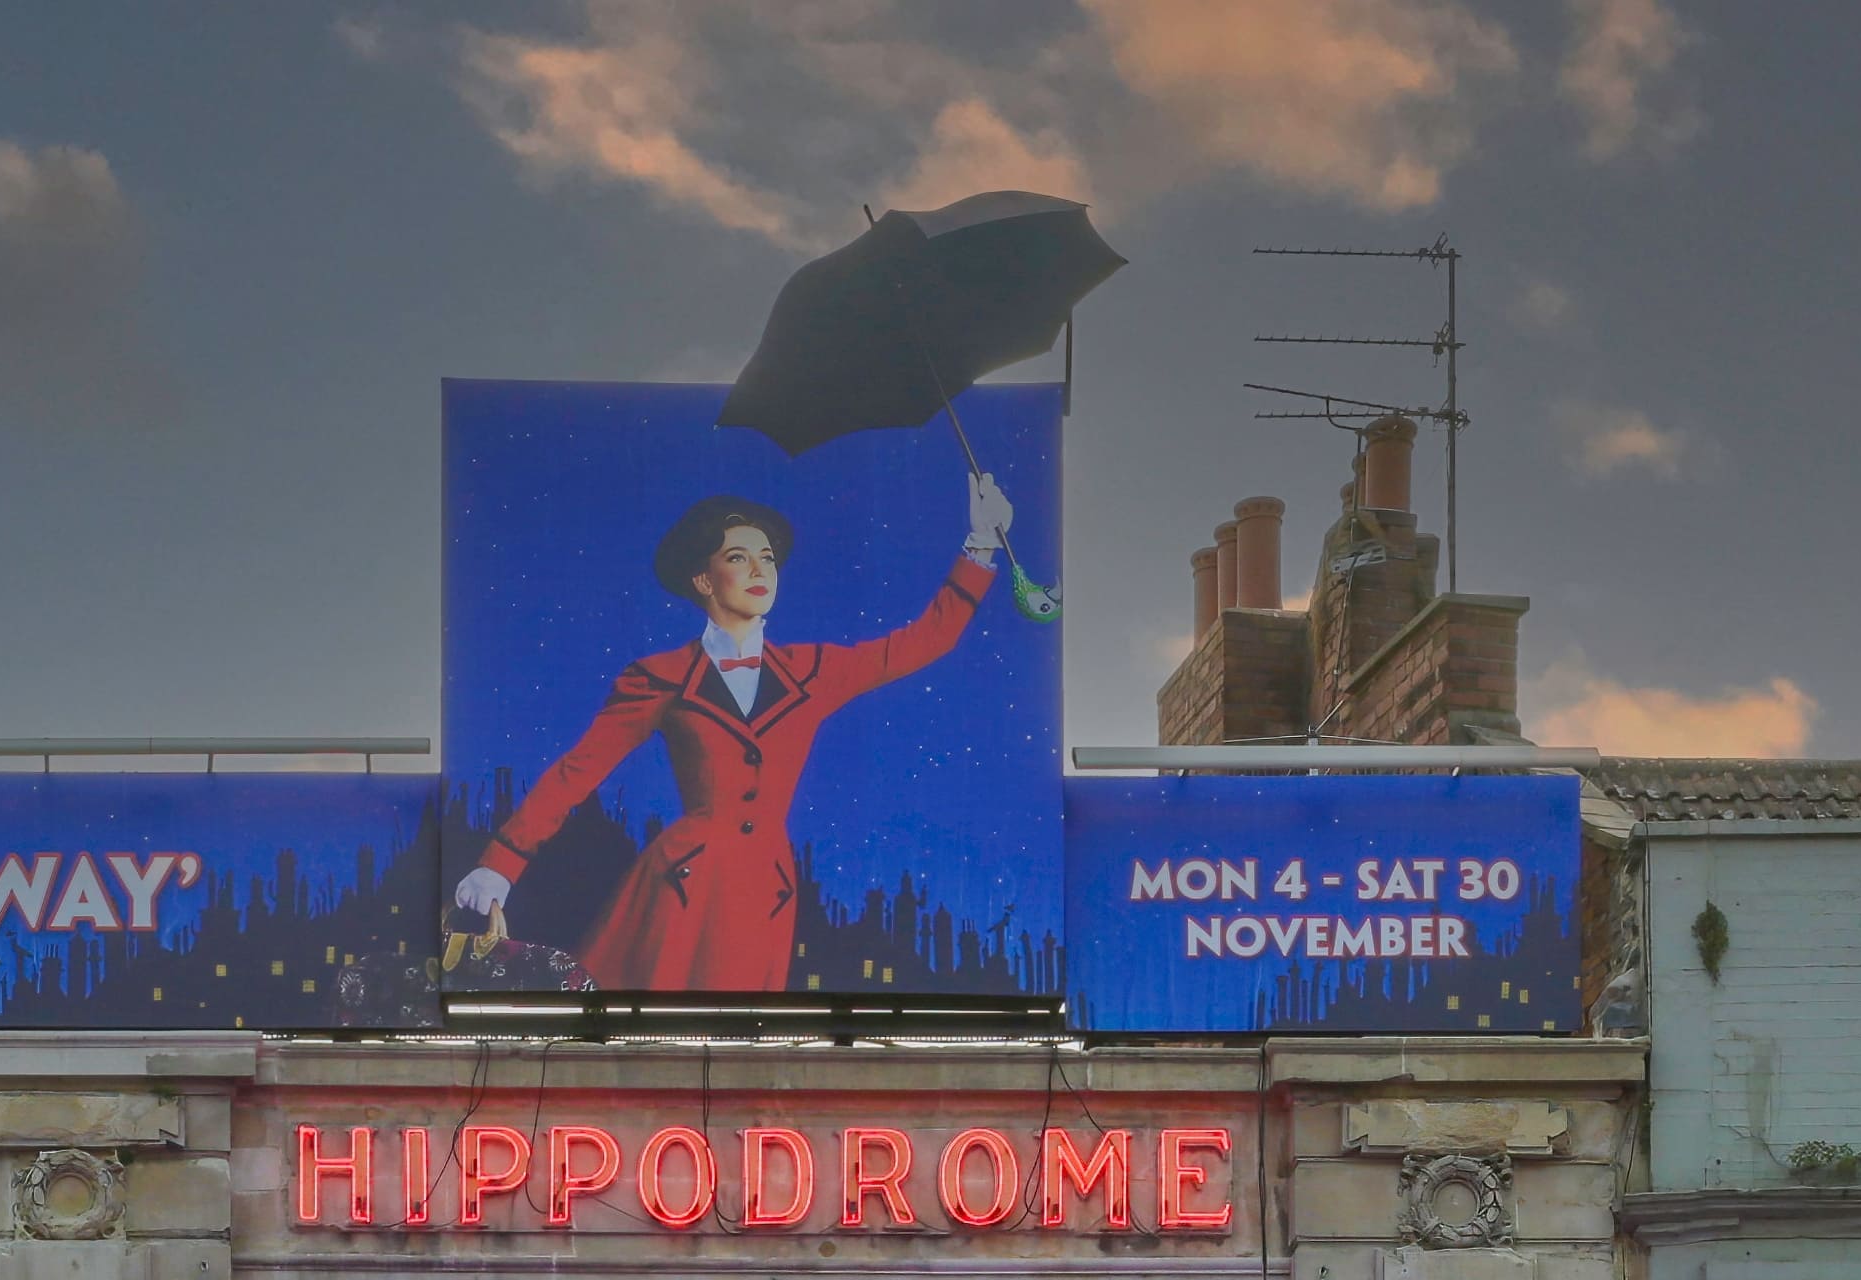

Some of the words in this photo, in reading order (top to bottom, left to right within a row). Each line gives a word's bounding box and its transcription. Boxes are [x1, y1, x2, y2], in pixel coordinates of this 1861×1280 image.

[1130, 860, 1257, 900] MON
[1273, 860, 1307, 900] 4
[1357, 861, 1444, 900] SAT
[1459, 861, 1520, 900] 30
[1186, 916, 1470, 957] NOVEMBER
[296, 1125, 1233, 1228] HIPPODROME
